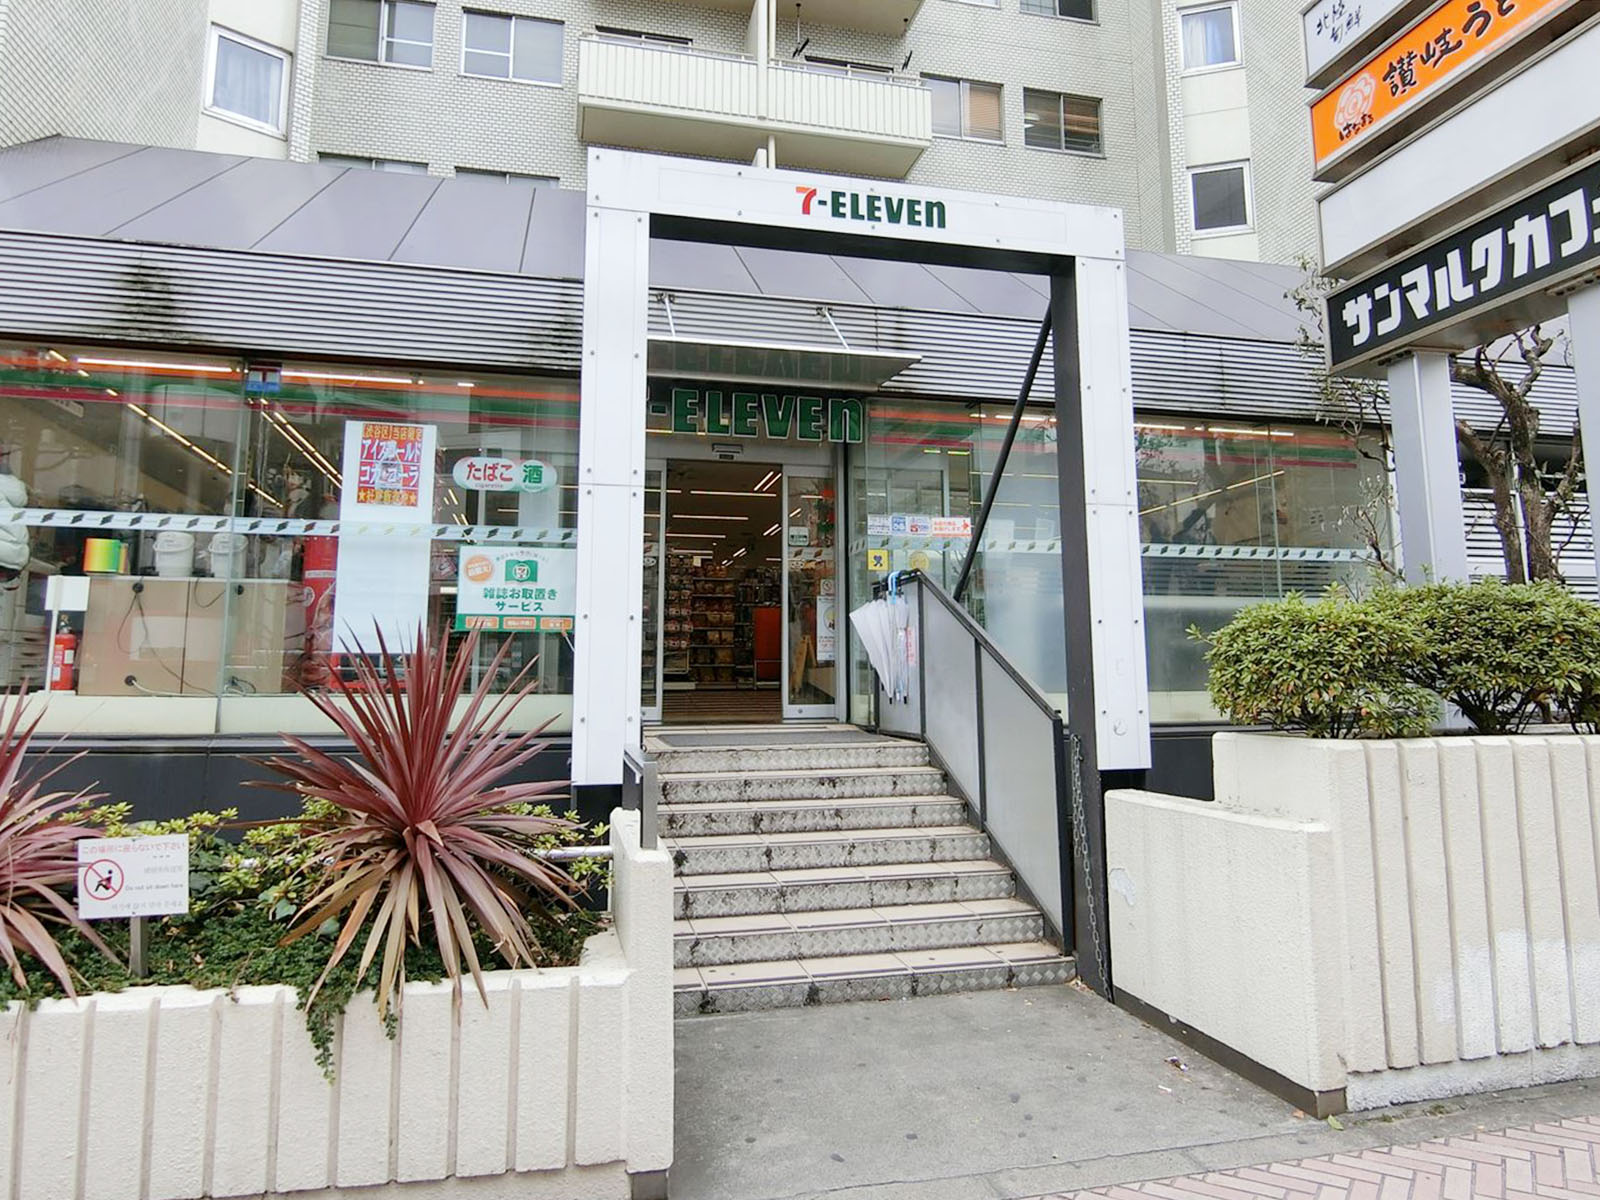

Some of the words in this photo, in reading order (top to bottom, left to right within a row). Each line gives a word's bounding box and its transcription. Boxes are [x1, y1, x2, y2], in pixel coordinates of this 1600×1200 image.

[466, 461, 513, 482] たばこ
[522, 464, 543, 484] 酒
[483, 587, 558, 600] 雑誌お取置き
[495, 601, 544, 612] サービス
